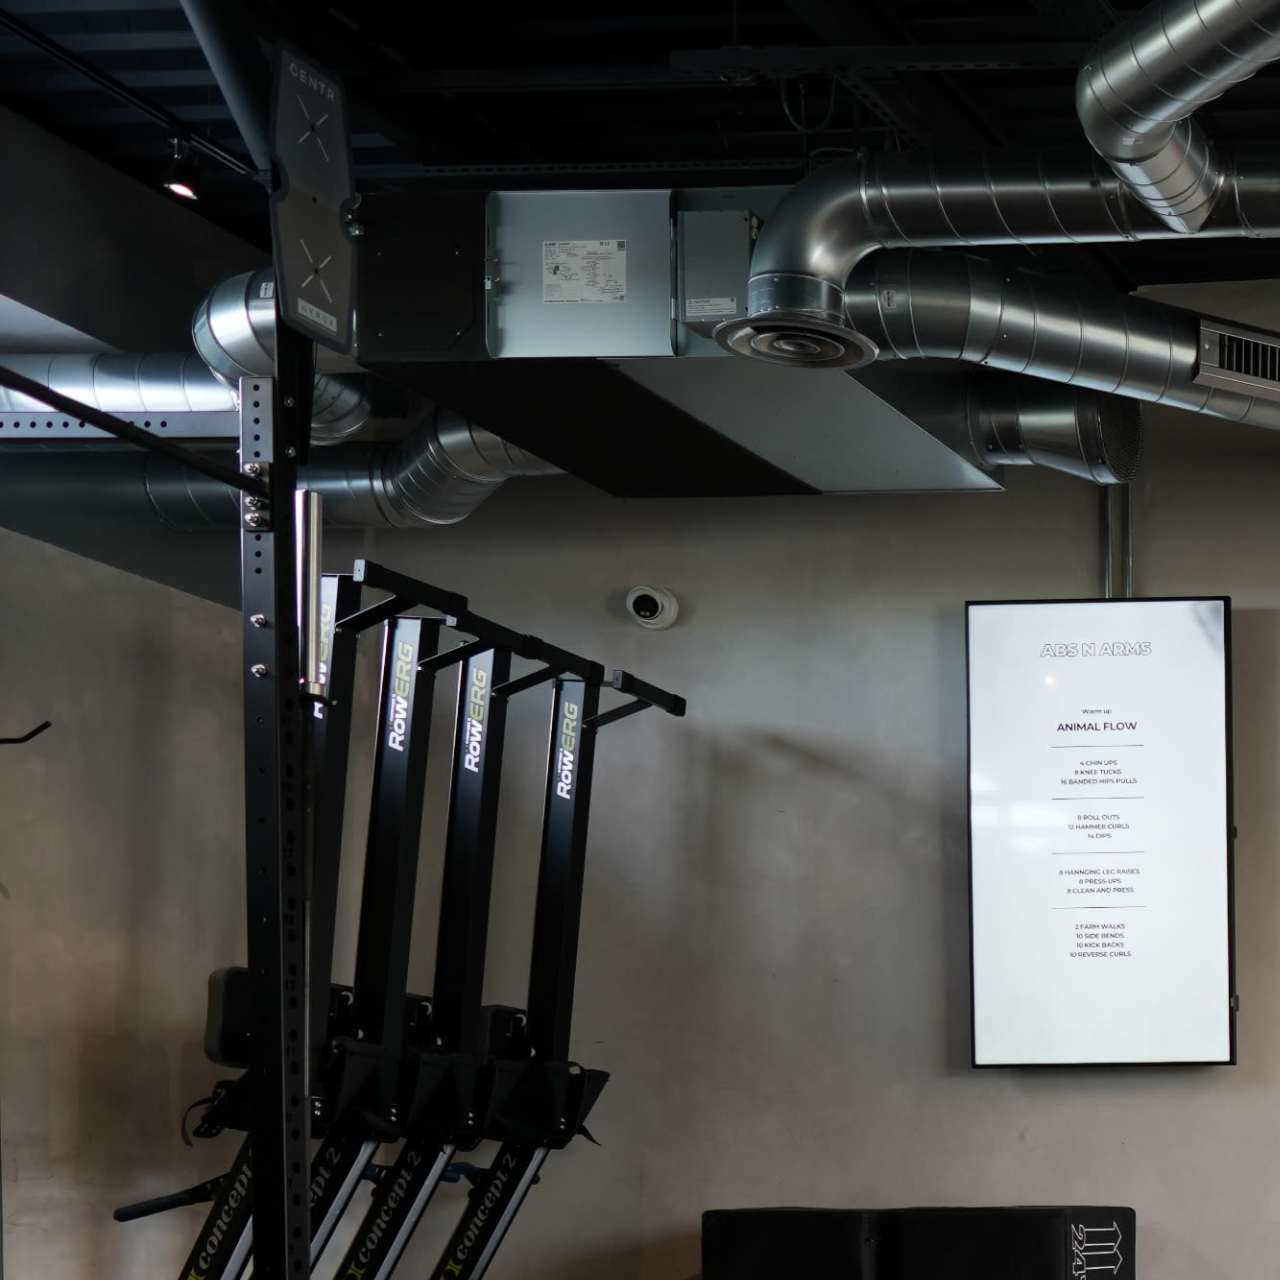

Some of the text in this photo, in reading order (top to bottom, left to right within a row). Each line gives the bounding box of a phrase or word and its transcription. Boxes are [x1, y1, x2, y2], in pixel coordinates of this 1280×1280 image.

[289, 63, 335, 104] CENTR
[1040, 641, 1152, 658] ABS N ARMS
[1057, 721, 1138, 732] ANIMAL FLOW
